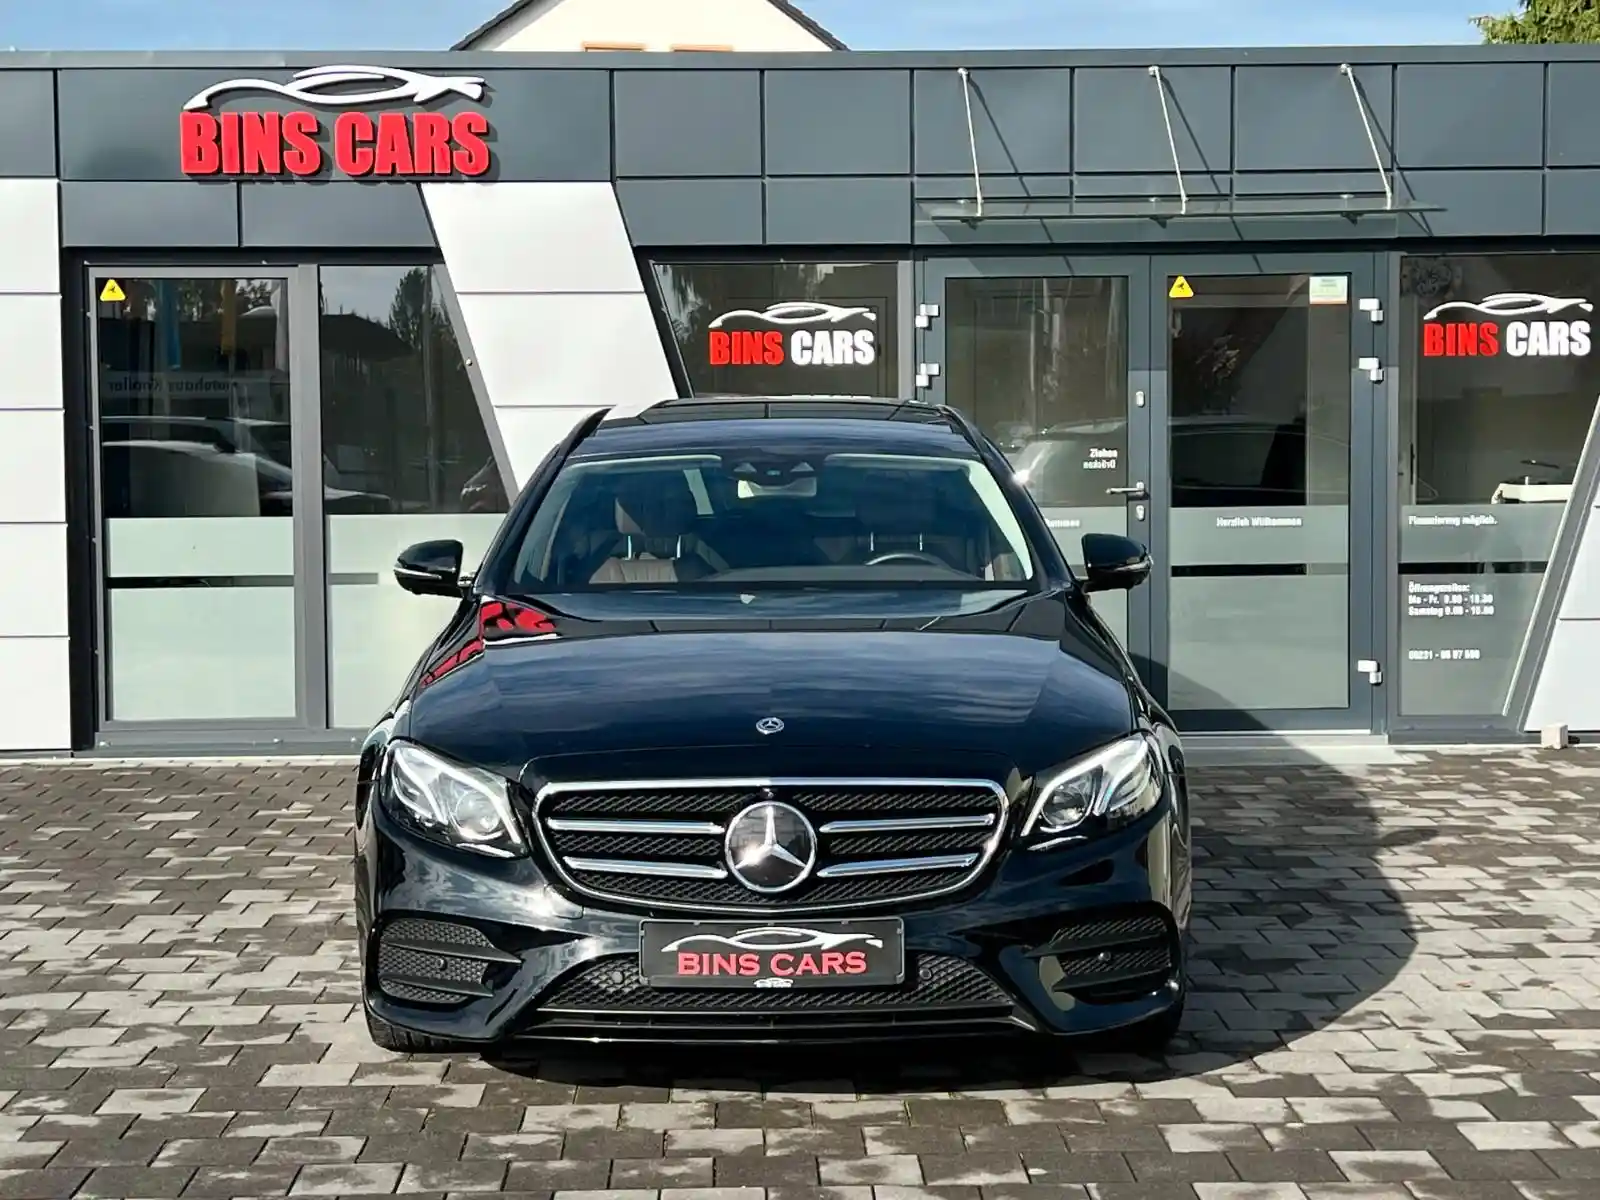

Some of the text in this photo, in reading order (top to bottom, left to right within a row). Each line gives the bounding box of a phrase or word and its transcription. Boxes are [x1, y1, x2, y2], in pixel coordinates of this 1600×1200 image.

[180, 111, 489, 176] BINS CARS
[709, 329, 875, 366] BINS CARS
[1423, 320, 1592, 357] BINS CARS
[678, 951, 867, 976] BINS CARS
